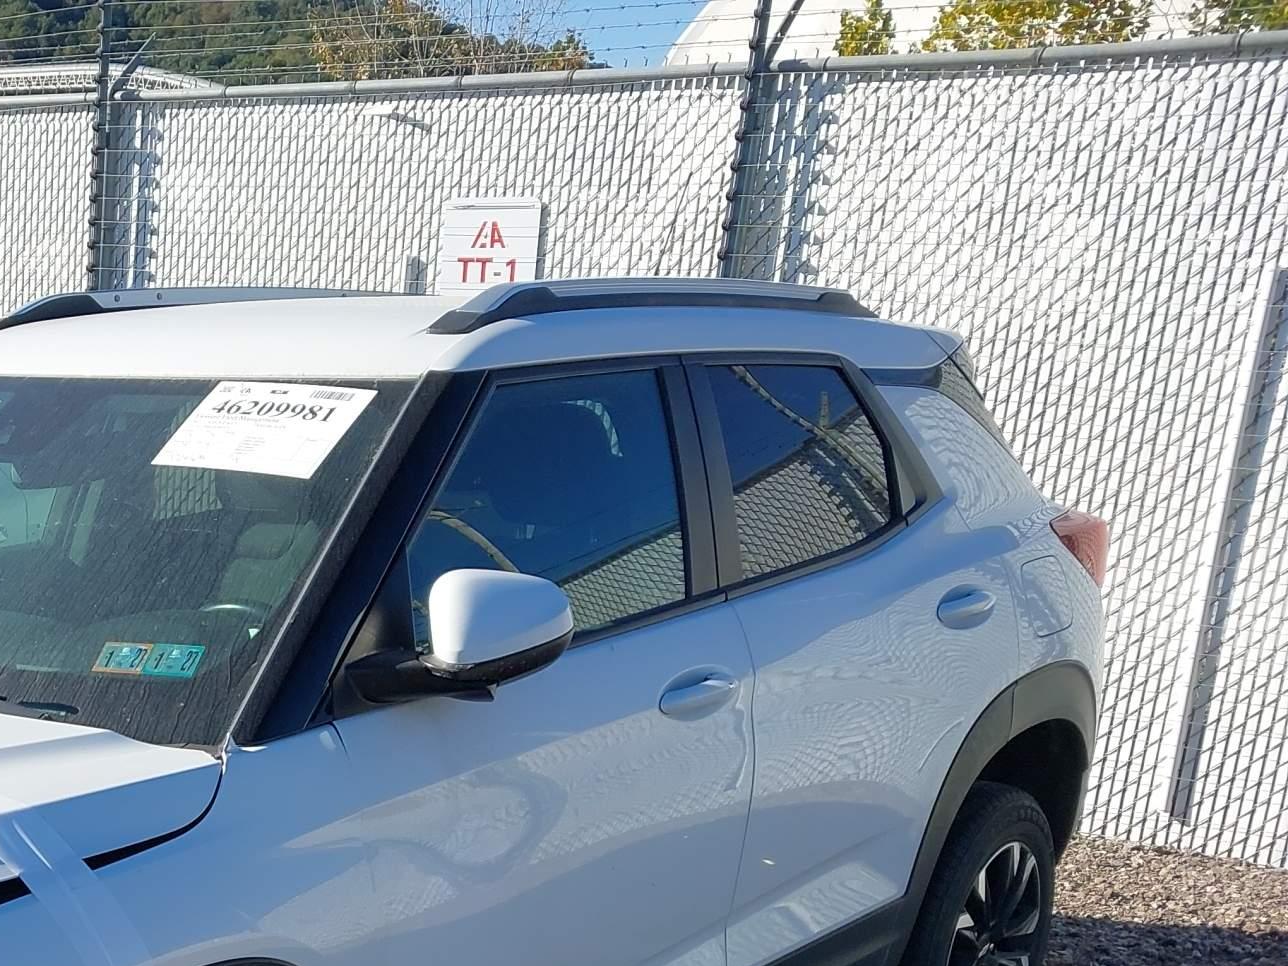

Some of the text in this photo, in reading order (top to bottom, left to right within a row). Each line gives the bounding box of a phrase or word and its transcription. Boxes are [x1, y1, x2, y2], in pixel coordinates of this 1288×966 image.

[457, 257, 517, 283] TT-1
[211, 399, 338, 423] 46209981
[180, 650, 200, 672] 27
